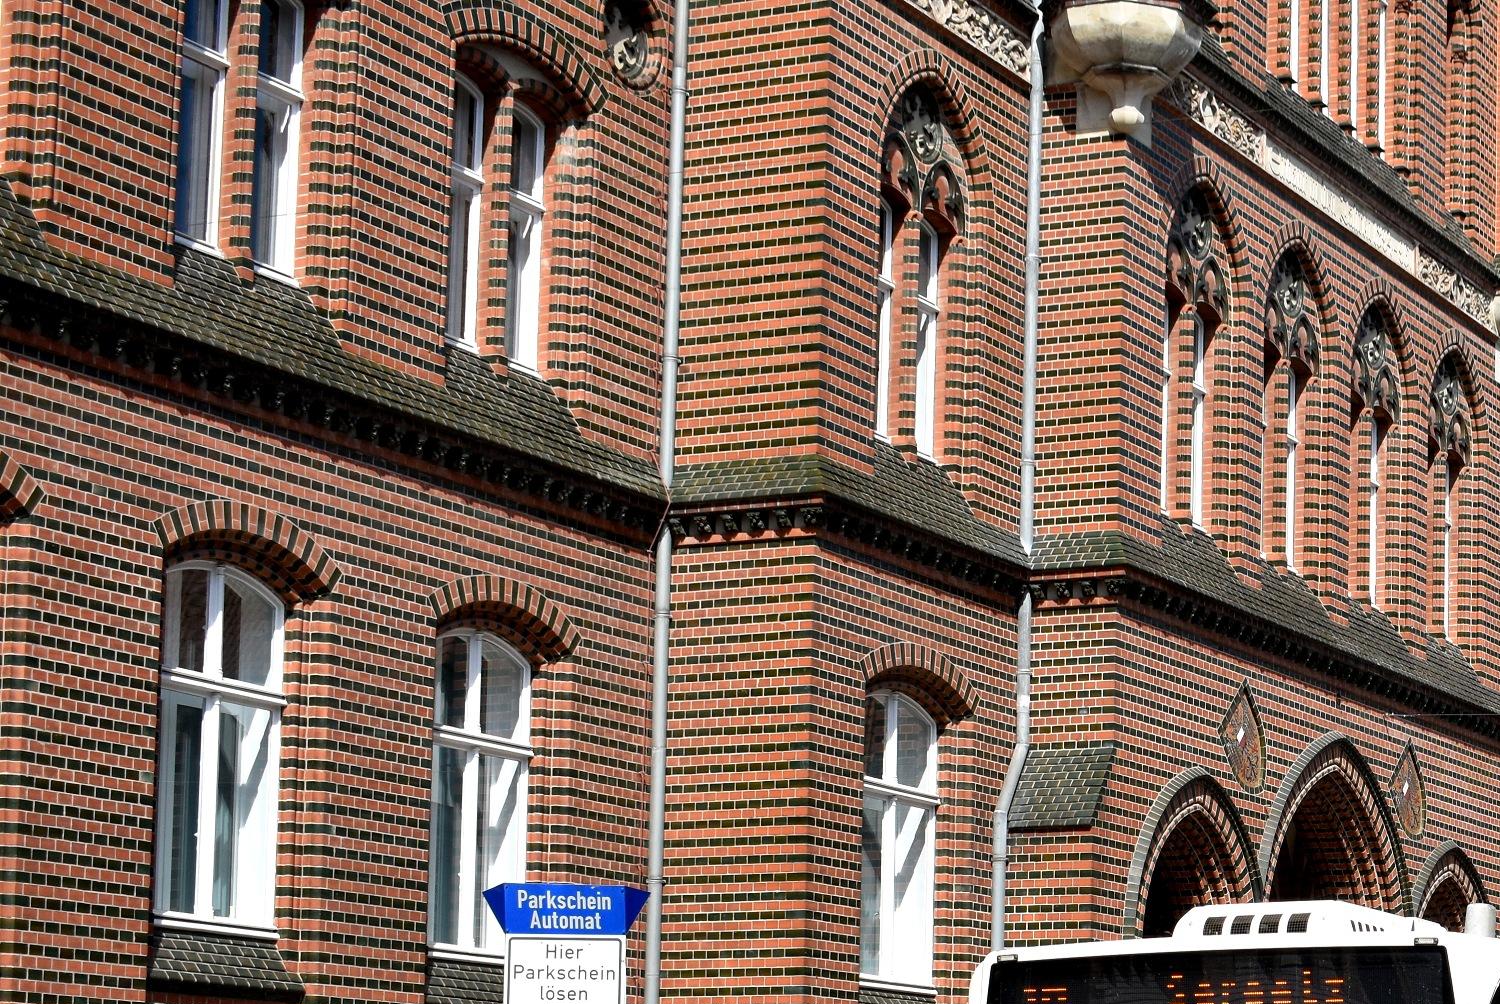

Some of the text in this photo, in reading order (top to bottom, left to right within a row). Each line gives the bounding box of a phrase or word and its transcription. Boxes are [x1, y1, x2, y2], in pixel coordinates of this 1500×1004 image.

[517, 890, 612, 910] Parkschein
[530, 911, 602, 929] Automat
[545, 944, 584, 959] Hier
[513, 964, 616, 981] Parkschein
[540, 985, 588, 1001] lösen
